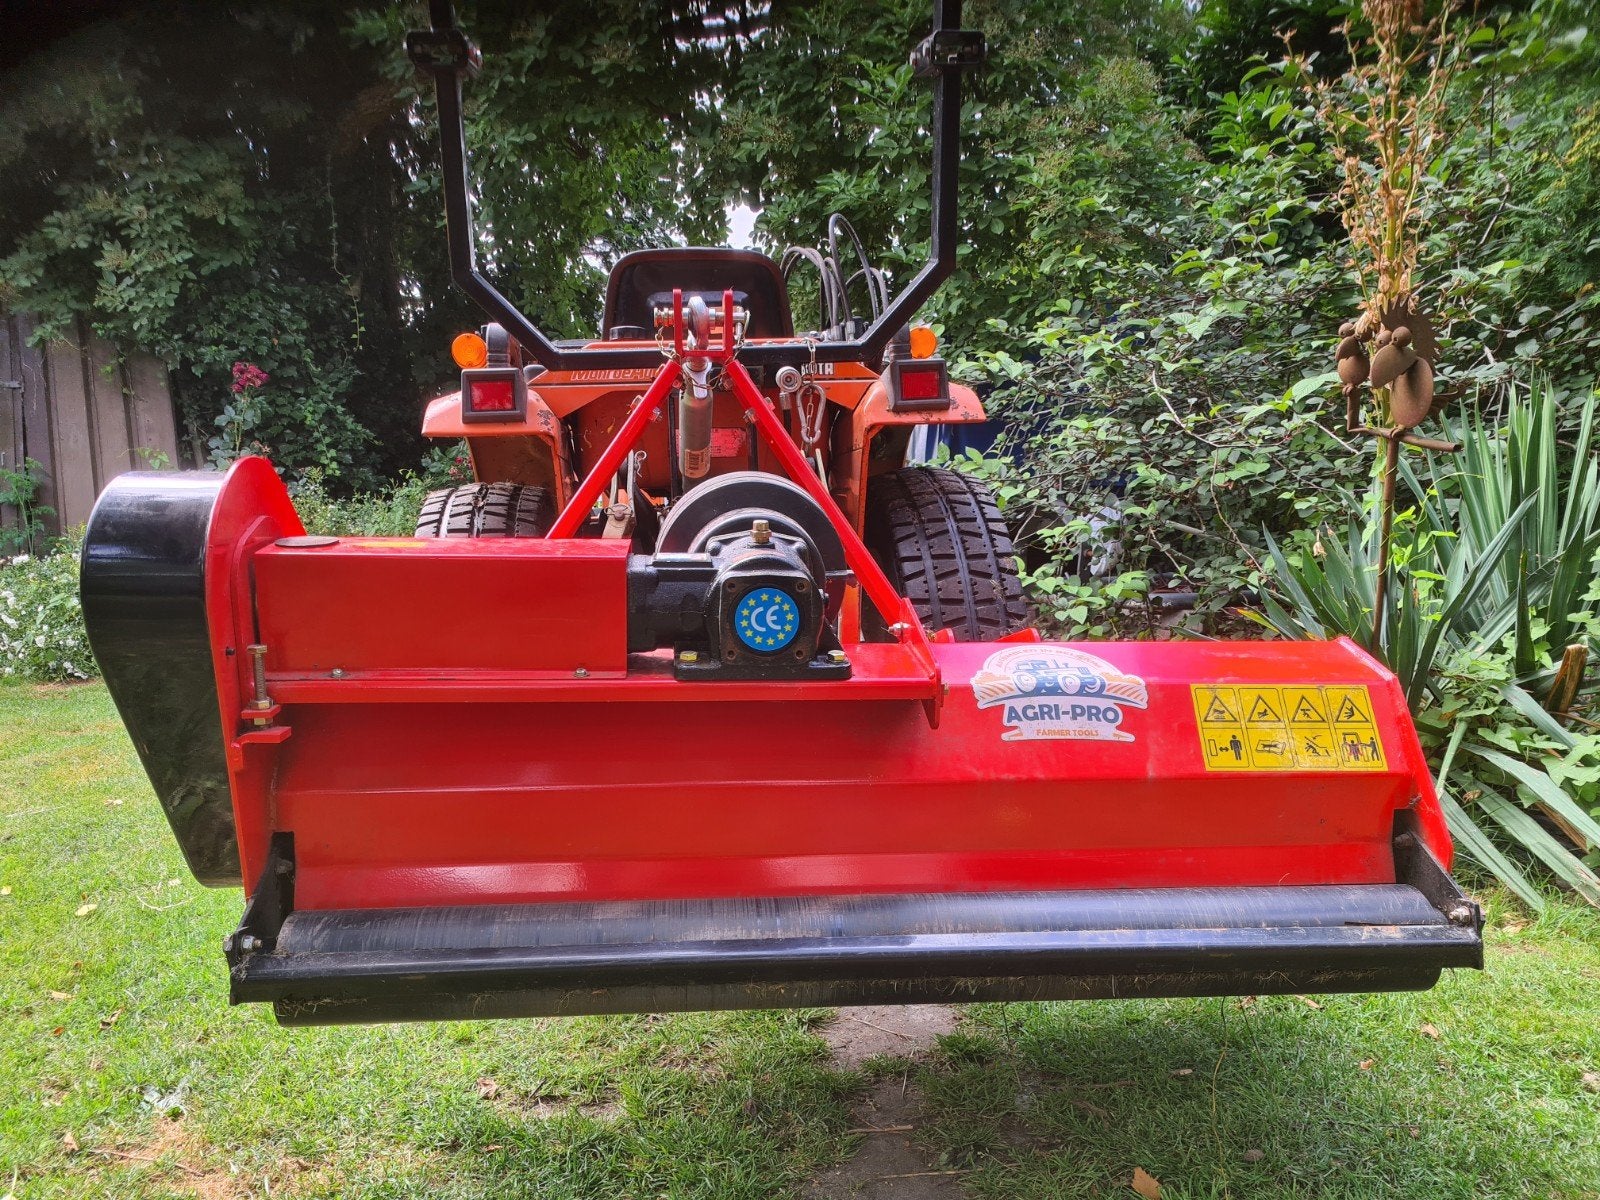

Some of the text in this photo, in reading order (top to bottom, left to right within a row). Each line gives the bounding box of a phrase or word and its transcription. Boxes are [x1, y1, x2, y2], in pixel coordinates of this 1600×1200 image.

[751, 605, 781, 632] CE
[1007, 703, 1120, 724] AGRI-PRO
[1036, 729, 1099, 737] FARMER TOOLS
